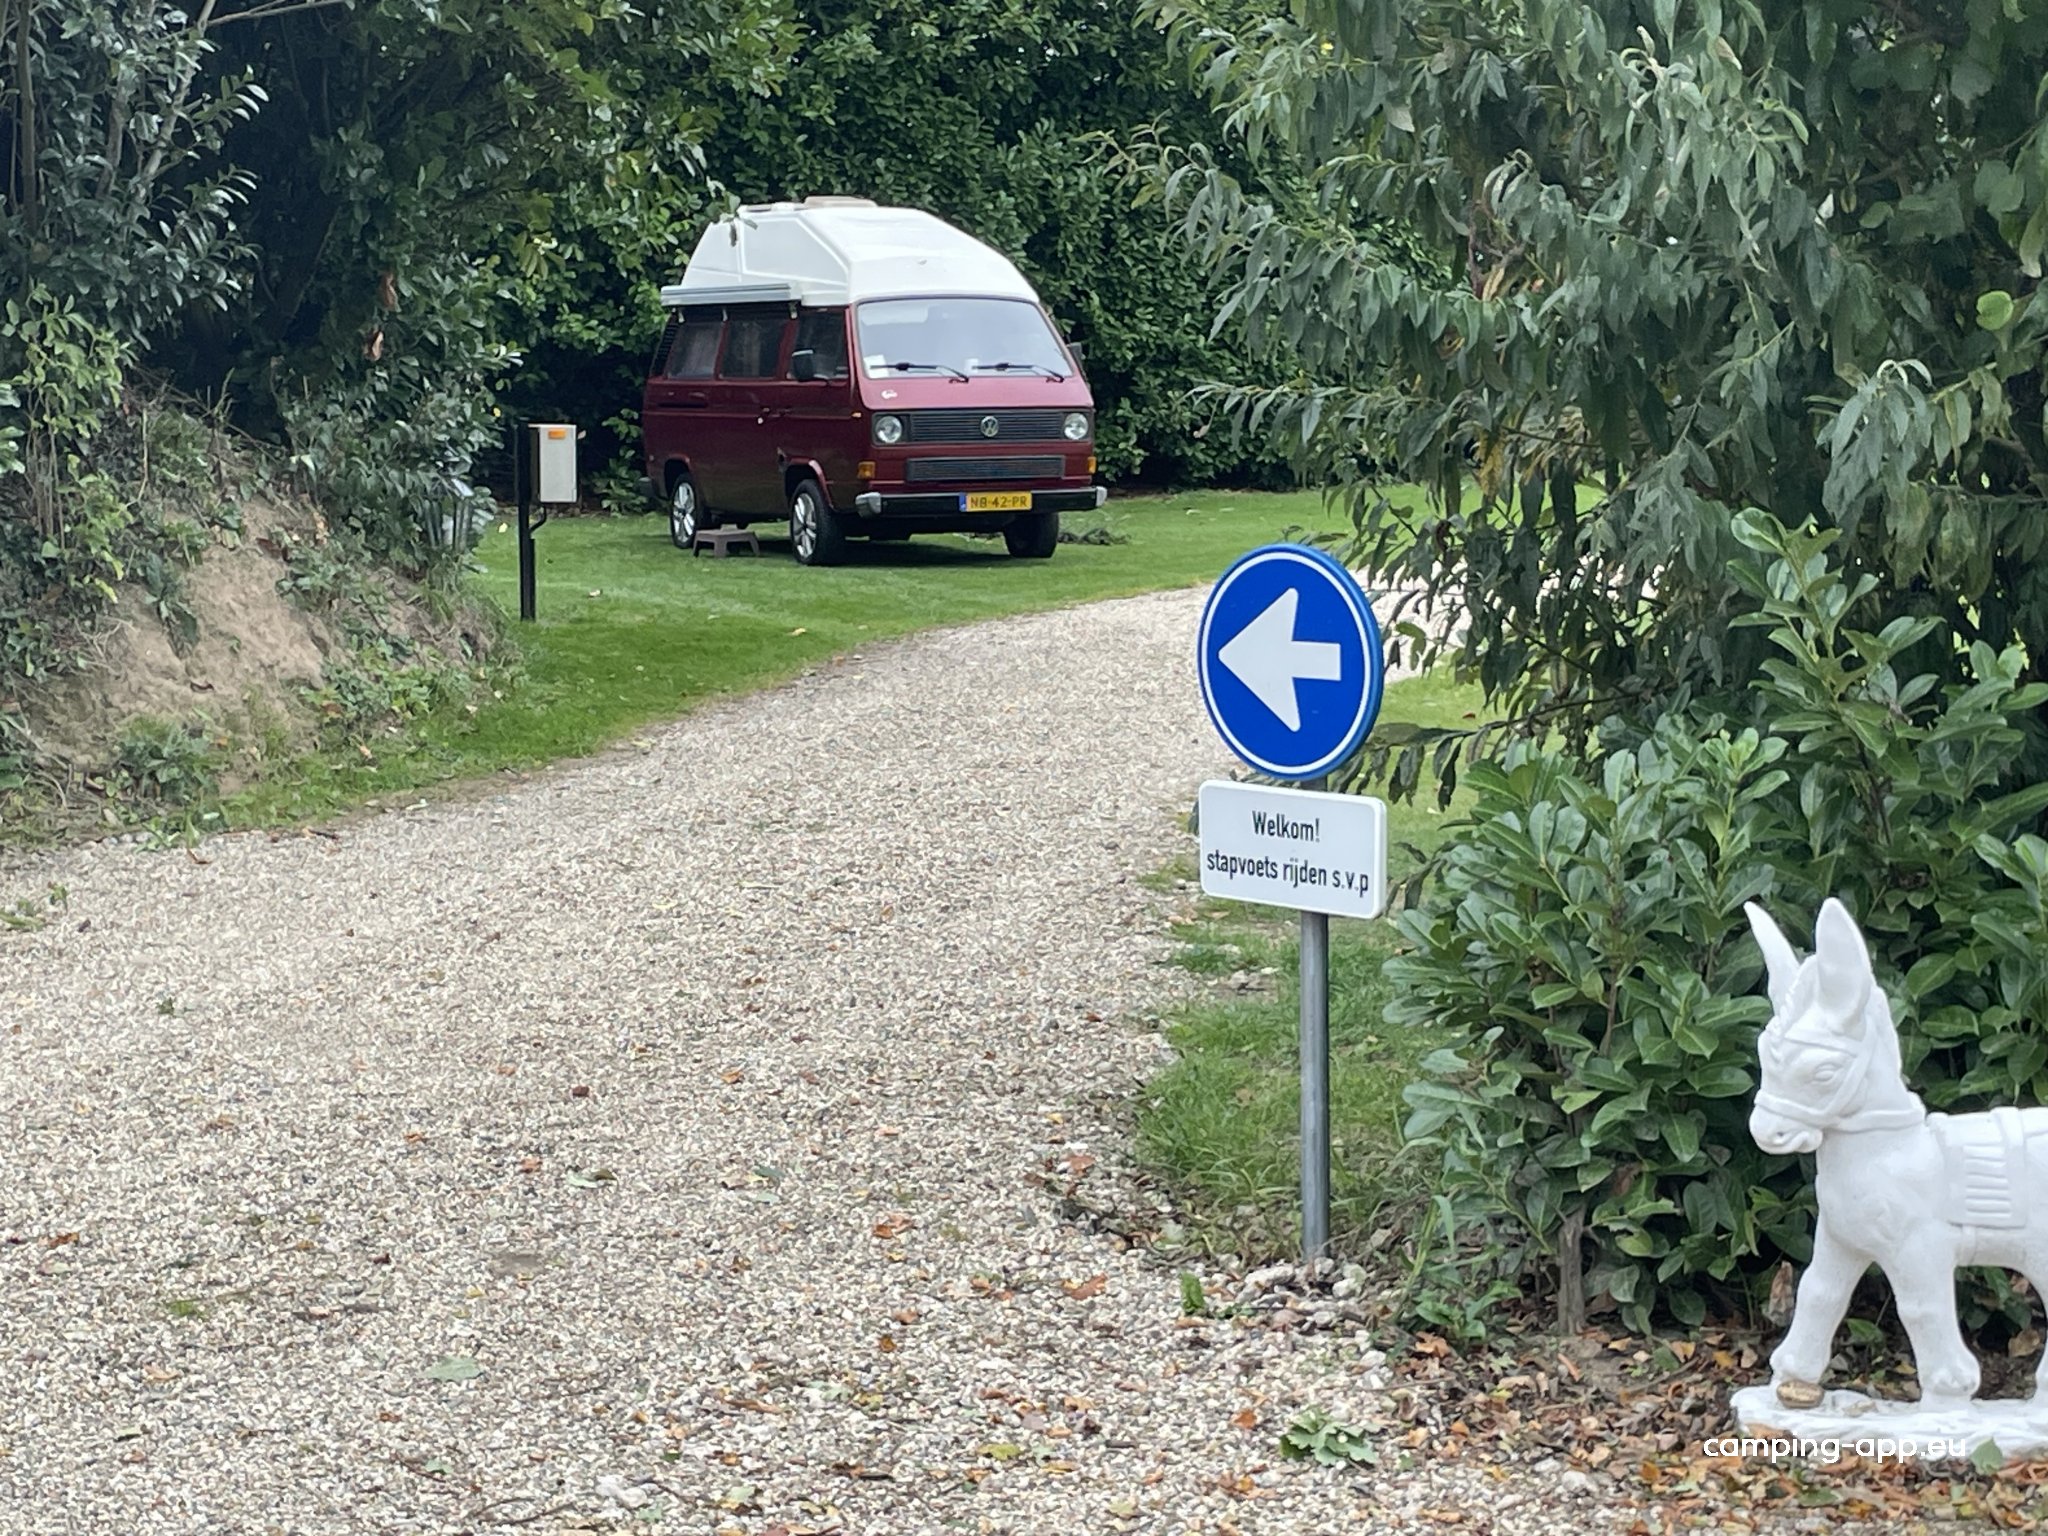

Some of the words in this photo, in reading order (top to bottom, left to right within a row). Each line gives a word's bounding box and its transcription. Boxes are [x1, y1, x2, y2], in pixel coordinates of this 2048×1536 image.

[970, 496, 1028, 508] NB-42-PR
[1252, 810, 1321, 842] Welkom!
[1207, 849, 1278, 880] stapvoets
[1283, 857, 1327, 888] rijden
[1332, 869, 1369, 898] s.v.p
